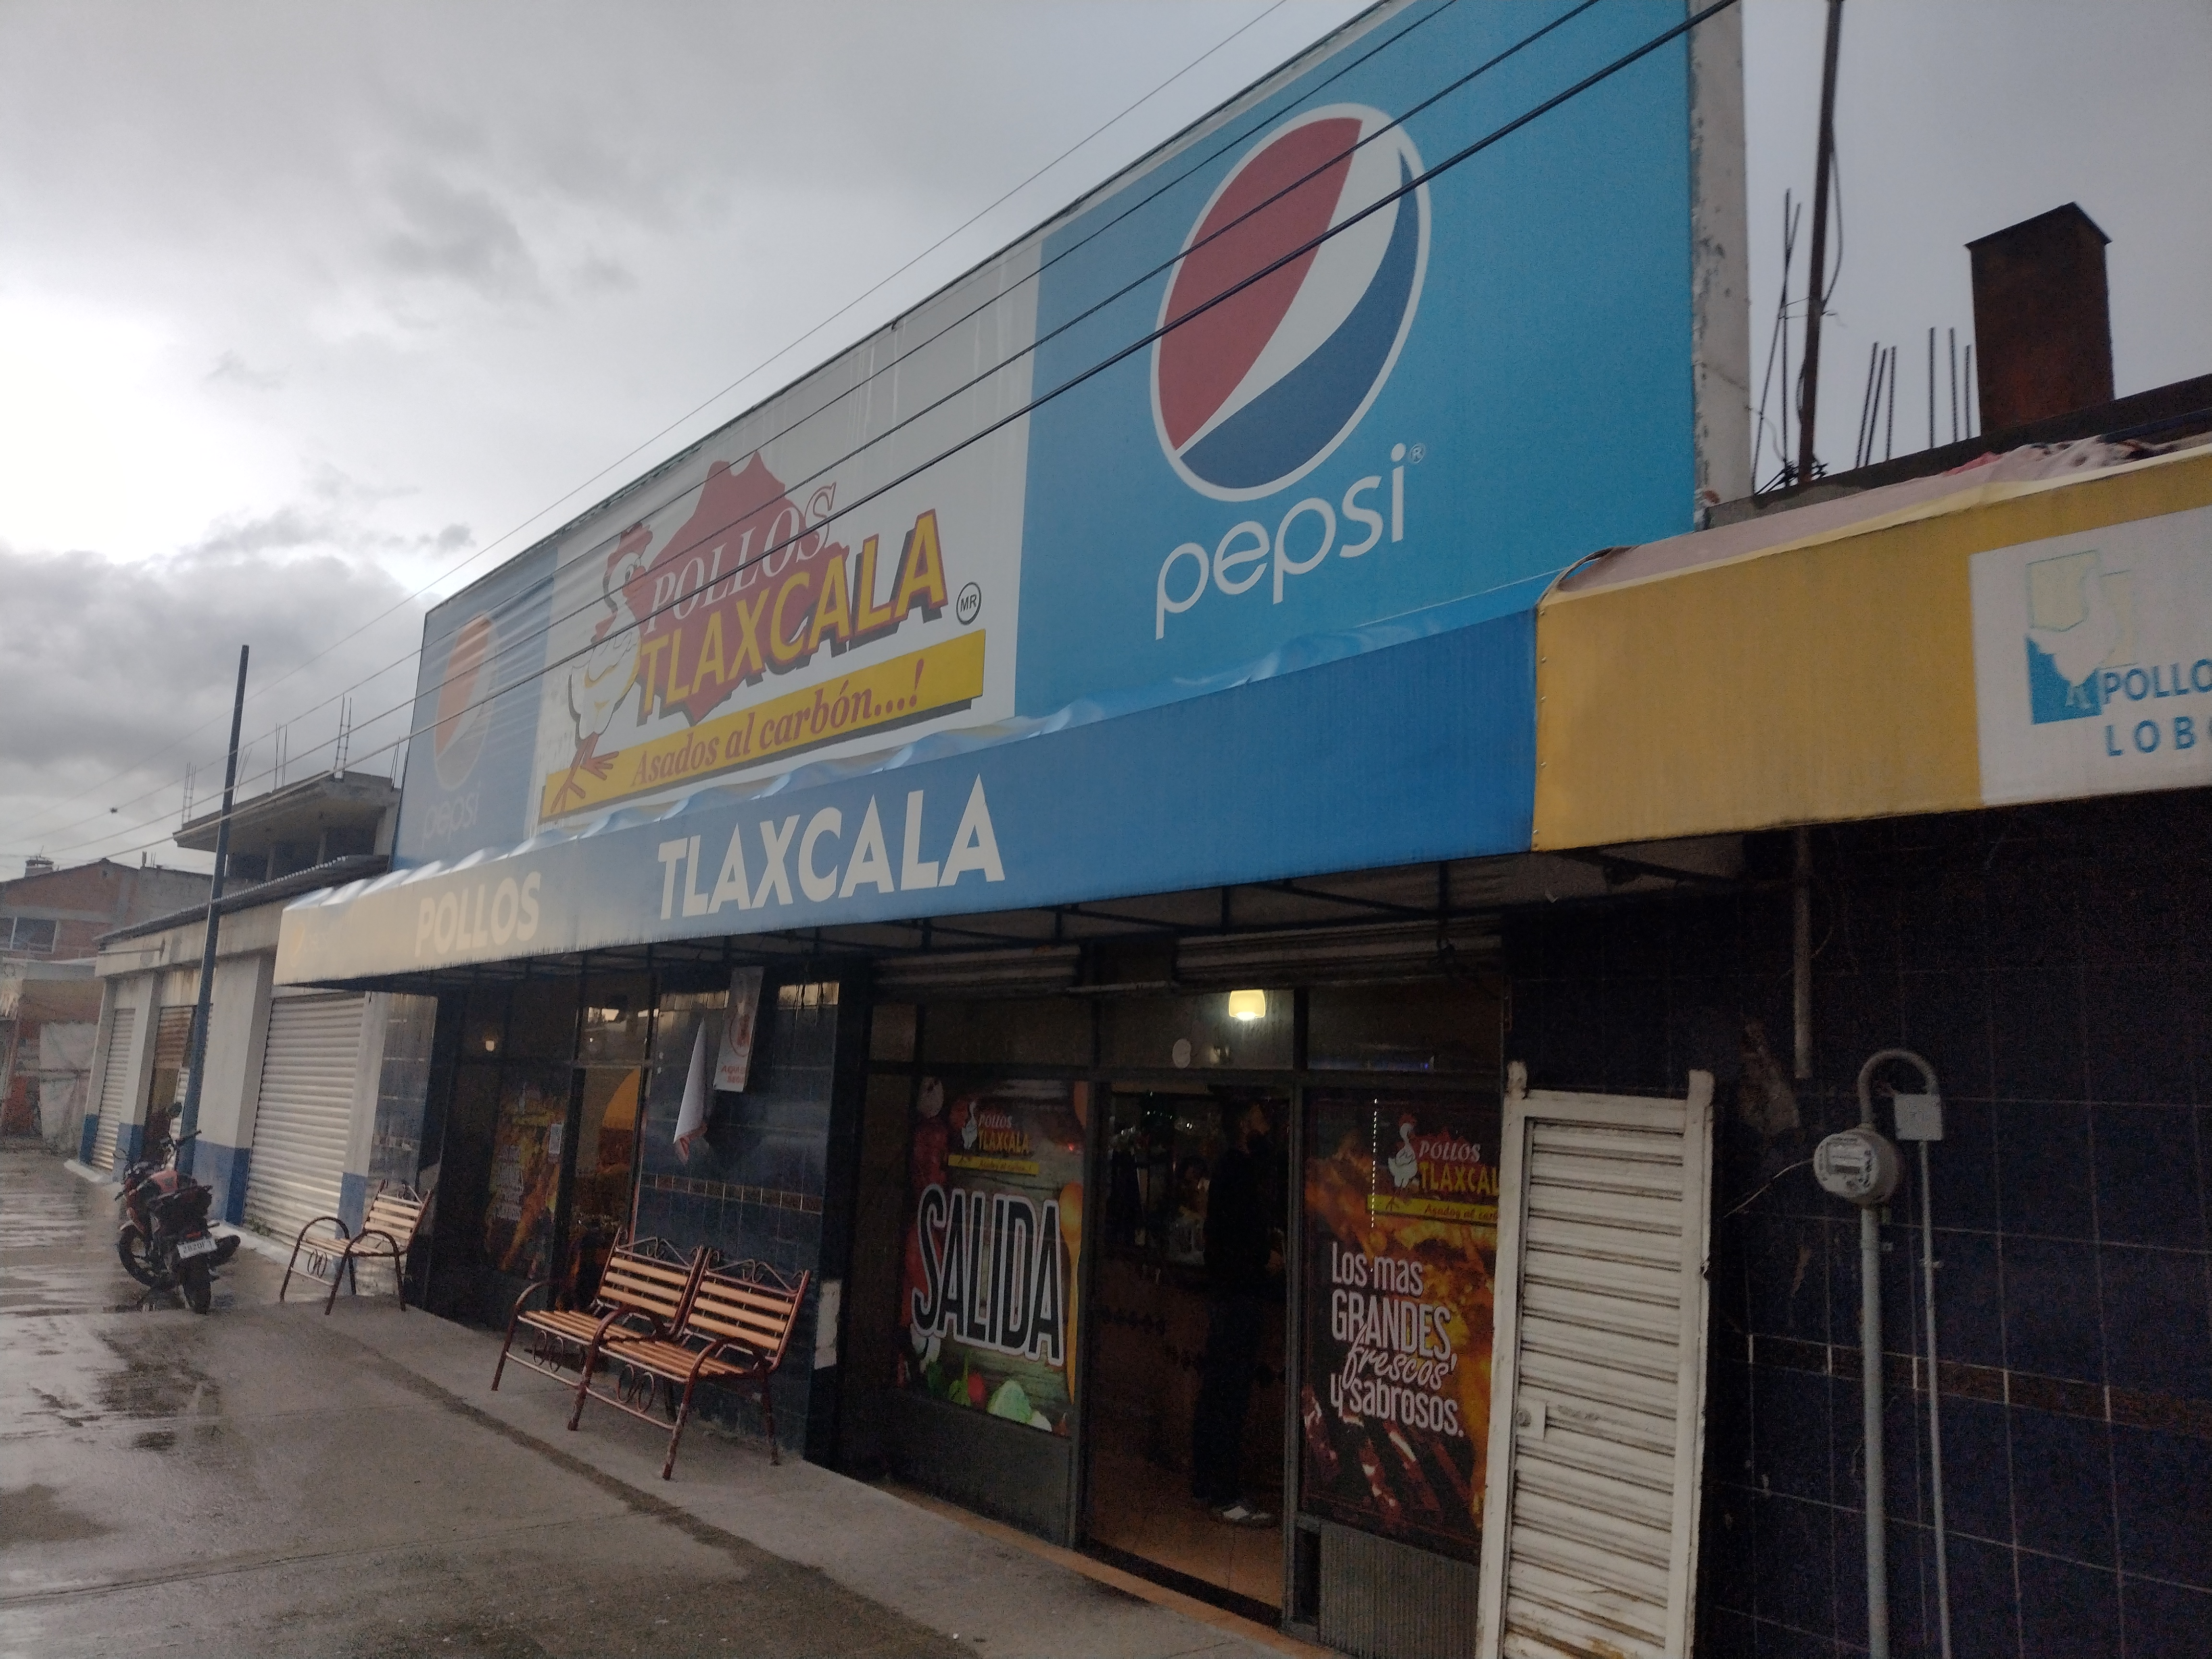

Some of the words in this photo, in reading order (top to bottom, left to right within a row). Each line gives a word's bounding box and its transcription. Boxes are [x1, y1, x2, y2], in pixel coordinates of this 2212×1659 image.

[644, 482, 837, 635] POLLOS
[1155, 443, 1405, 640] pepsi
[640, 508, 949, 717] TLAXCALA
[960, 594, 977, 613] MR
[630, 732, 720, 787] Asados
[725, 711, 755, 760] al
[2104, 715, 2212, 757] LOB
[414, 870, 541, 958] POLLOS
[657, 773, 1005, 920] TLAXCALA
[978, 1129, 1030, 1154] TLAXCALA
[911, 1184, 1065, 1367] SALIDA
[1332, 1241, 1368, 1287] Los
[1373, 1256, 1424, 1297] mas
[1343, 1322, 1450, 1391] frescos
